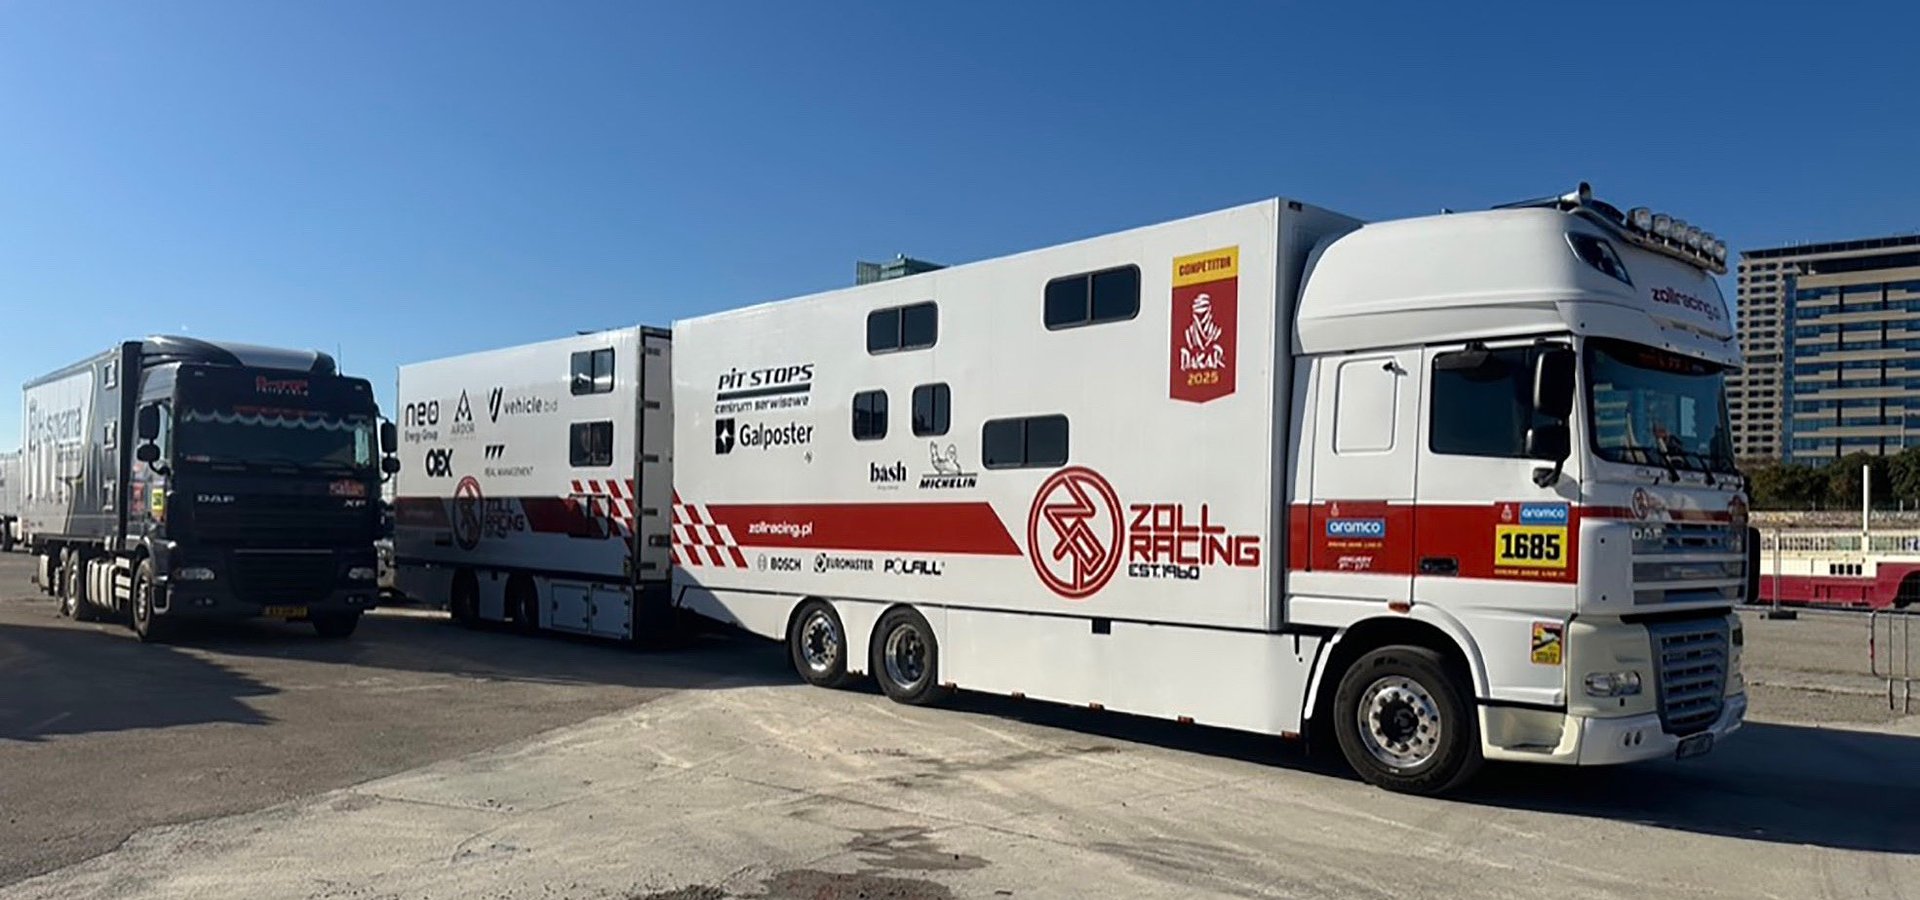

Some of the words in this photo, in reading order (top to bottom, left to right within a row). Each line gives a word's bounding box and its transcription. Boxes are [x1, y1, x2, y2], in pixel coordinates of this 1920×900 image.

[1178, 255, 1232, 277] COMPETITOR
[1180, 343, 1226, 372] DAKAR
[749, 363, 815, 386] STOPS
[1187, 371, 1219, 387] 2025
[405, 400, 440, 428] neo
[503, 396, 542, 415] vehicle
[714, 401, 753, 415] centrum
[754, 395, 809, 411] serwisowe
[739, 421, 814, 451] Galposter
[425, 447, 453, 478] OEX
[869, 460, 906, 483] bash
[919, 477, 976, 490] MICHELIN
[198, 494, 235, 503] DAF
[1129, 503, 1226, 534] ZOLL
[1521, 503, 1566, 519] aramco
[749, 521, 814, 538] zollracing.pl
[1329, 521, 1381, 534] aramco
[1632, 527, 1662, 540] DAF
[1129, 534, 1261, 567] RACING
[1501, 532, 1560, 560] 1685
[770, 557, 801, 572] BOSCH
[825, 557, 874, 571] EUROMASTER
